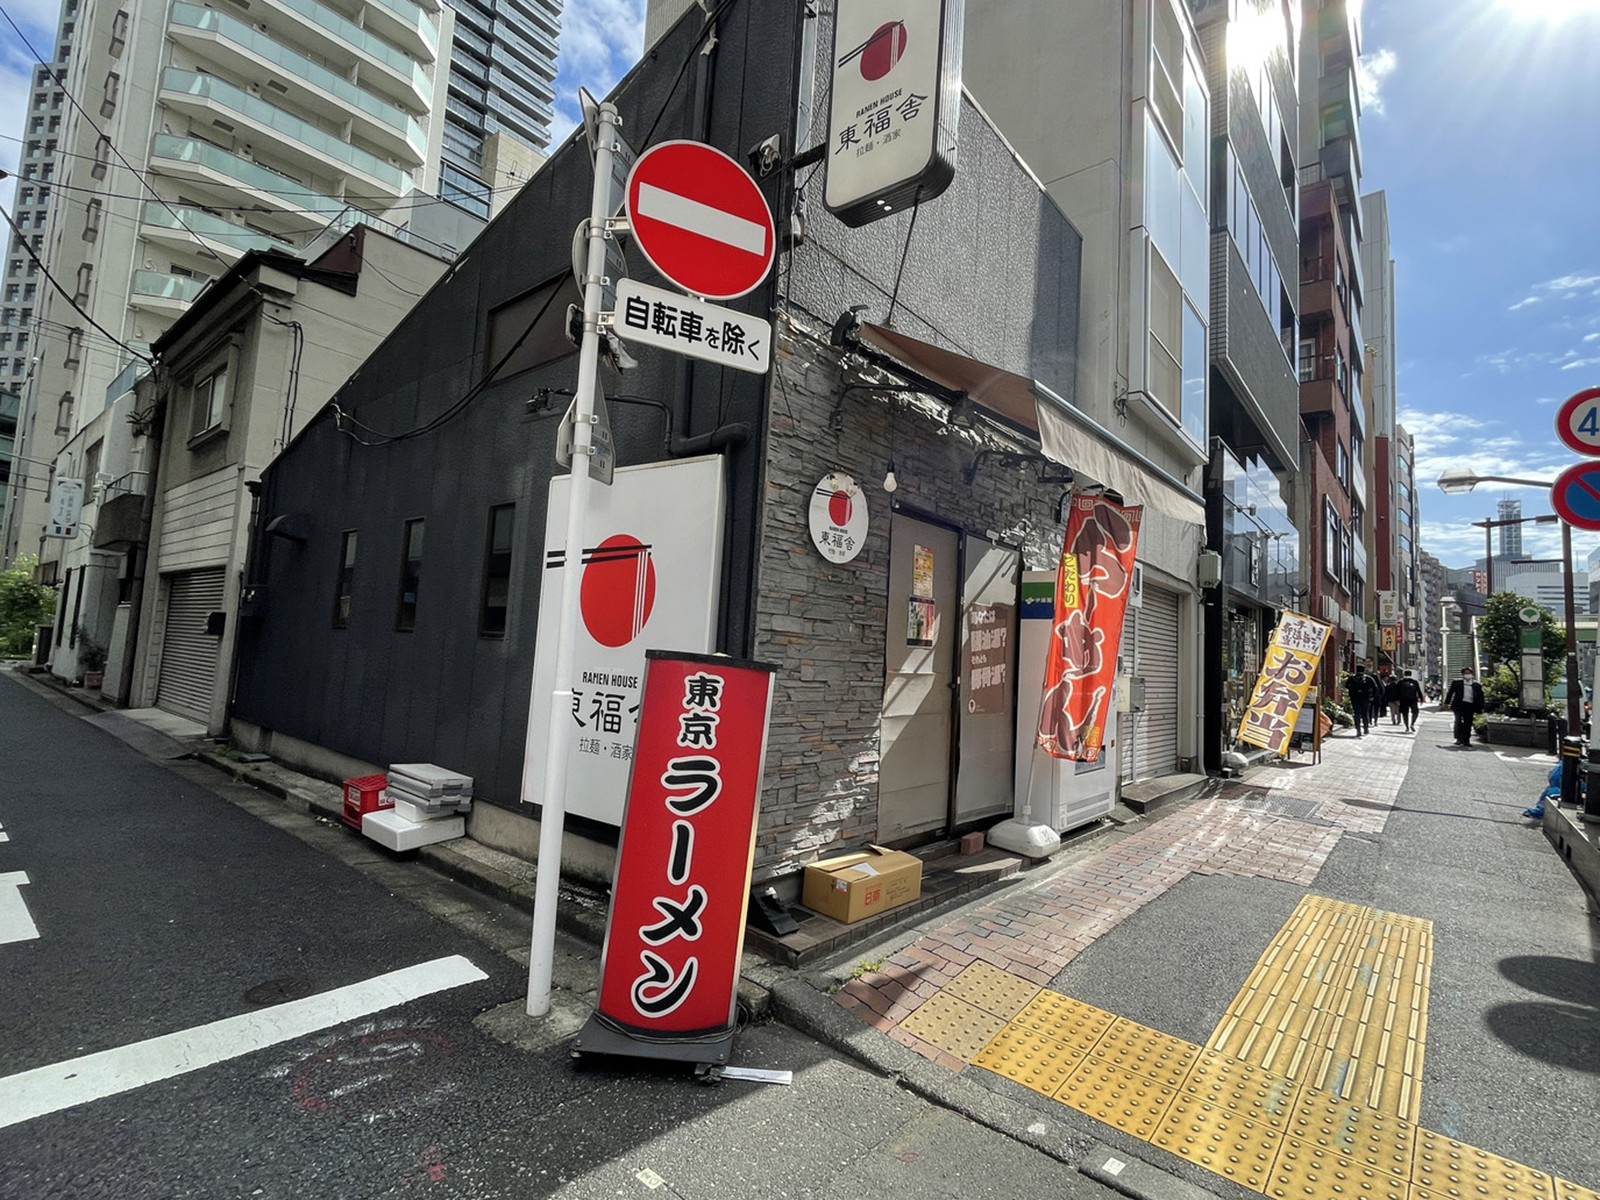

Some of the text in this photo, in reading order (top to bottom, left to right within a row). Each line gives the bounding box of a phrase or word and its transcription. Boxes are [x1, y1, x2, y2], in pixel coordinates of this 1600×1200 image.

[880, 87, 903, 105] HOUSE
[625, 296, 760, 361] 自転車を除く
[1577, 406, 1600, 436] 4
[582, 671, 638, 689] RAMEN HOUSE
[1242, 650, 1314, 751] お弁当
[633, 673, 722, 1016] 東京ラーメン
